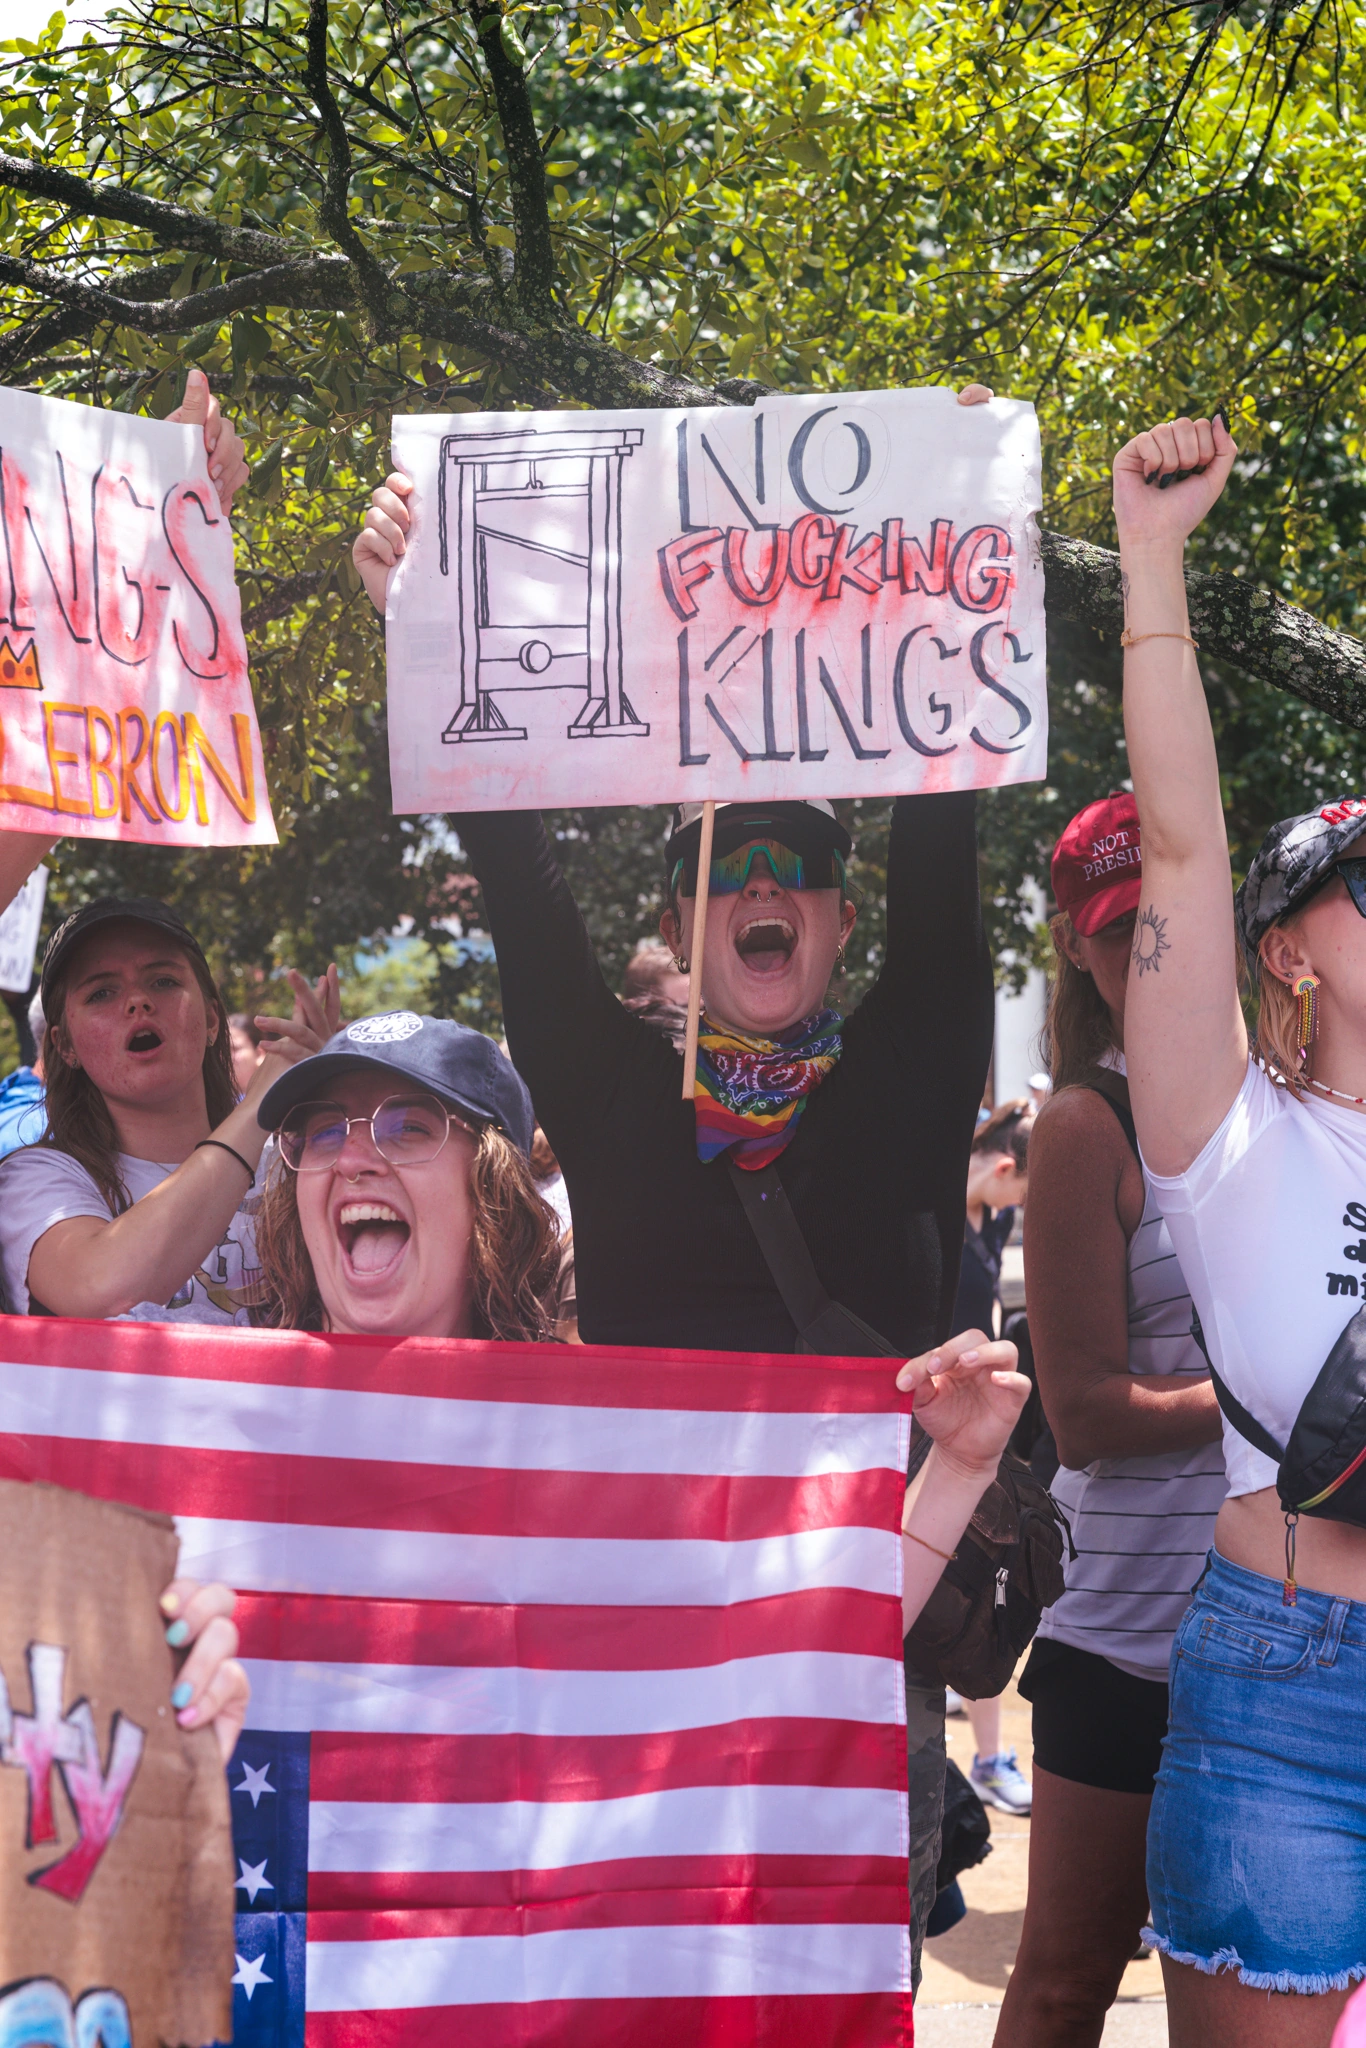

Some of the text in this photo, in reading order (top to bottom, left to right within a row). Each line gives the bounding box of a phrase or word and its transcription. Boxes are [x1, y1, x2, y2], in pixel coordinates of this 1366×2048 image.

[676, 404, 889, 533] NO
[0, 446, 229, 681] INGS
[657, 512, 1013, 622] FUCKING
[676, 620, 1036, 767] KINGS
[1091, 831, 1129, 857] NOT
